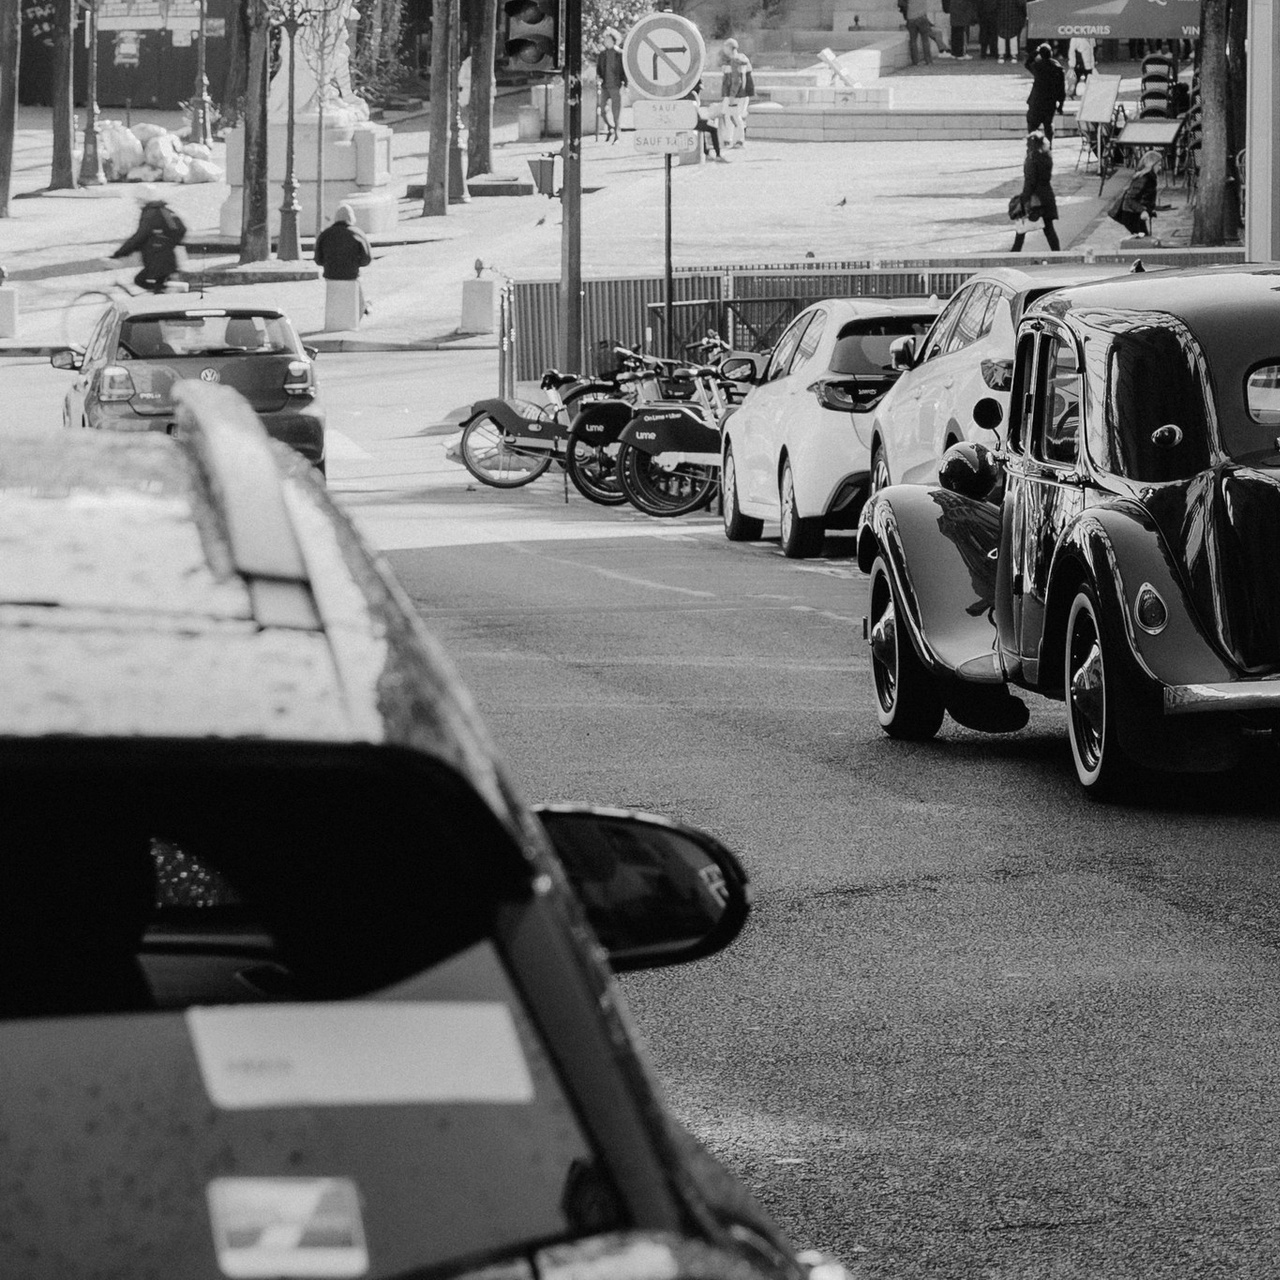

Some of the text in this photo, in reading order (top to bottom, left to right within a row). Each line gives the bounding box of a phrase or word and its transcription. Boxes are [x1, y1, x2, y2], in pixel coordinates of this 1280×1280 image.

[1057, 25, 1111, 36] COCKTAILS
[636, 136, 694, 146] SAUF TAS
[585, 424, 604, 432] Lime
[635, 431, 656, 440] Lime
